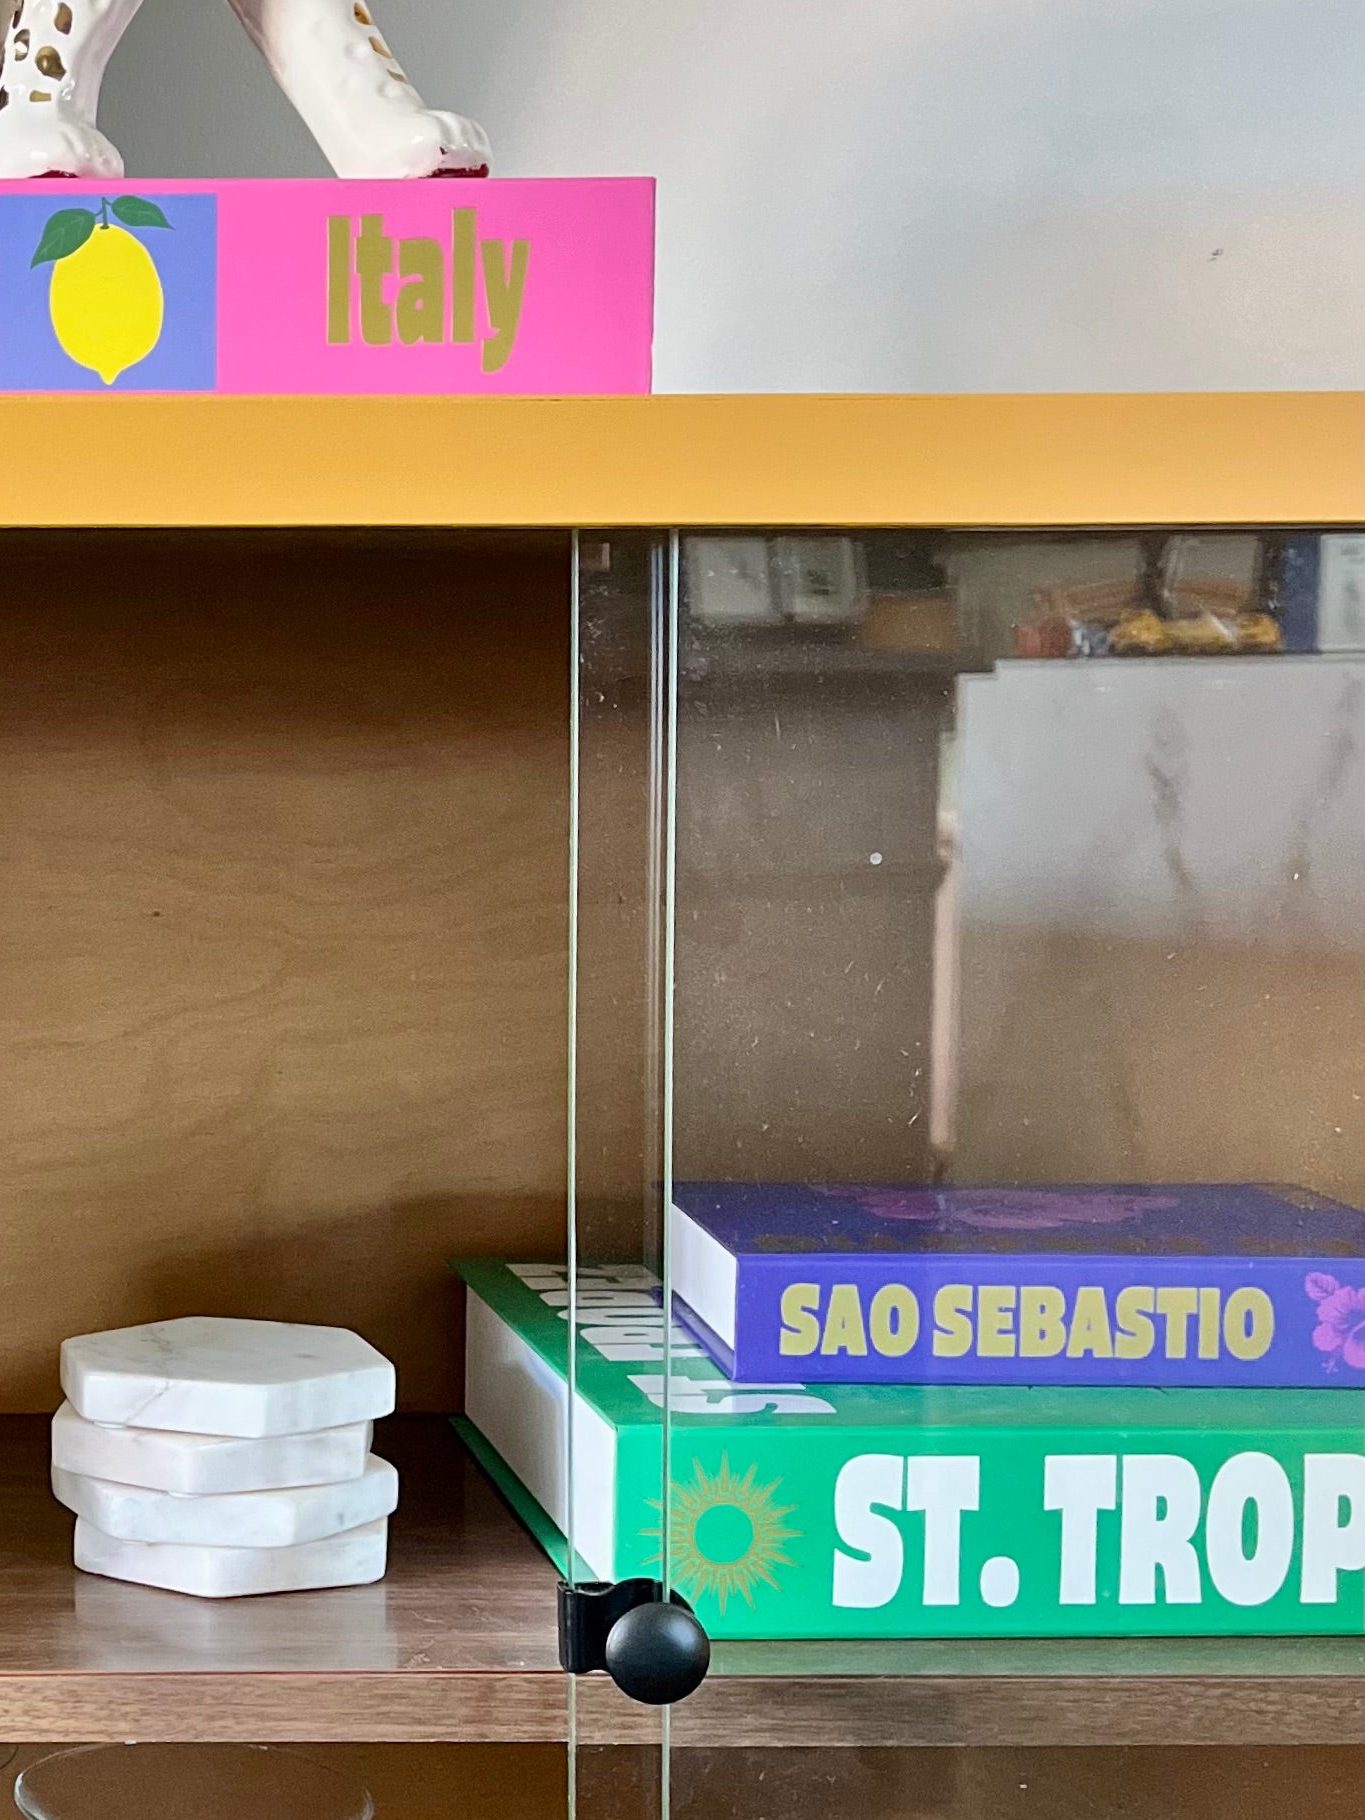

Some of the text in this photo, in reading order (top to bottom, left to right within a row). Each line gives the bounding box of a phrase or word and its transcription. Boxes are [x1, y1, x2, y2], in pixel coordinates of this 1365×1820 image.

[326, 206, 530, 373] Italy
[779, 1283, 1275, 1361] SAO SEBASTIO
[832, 1451, 1365, 1608] ST. TROP
